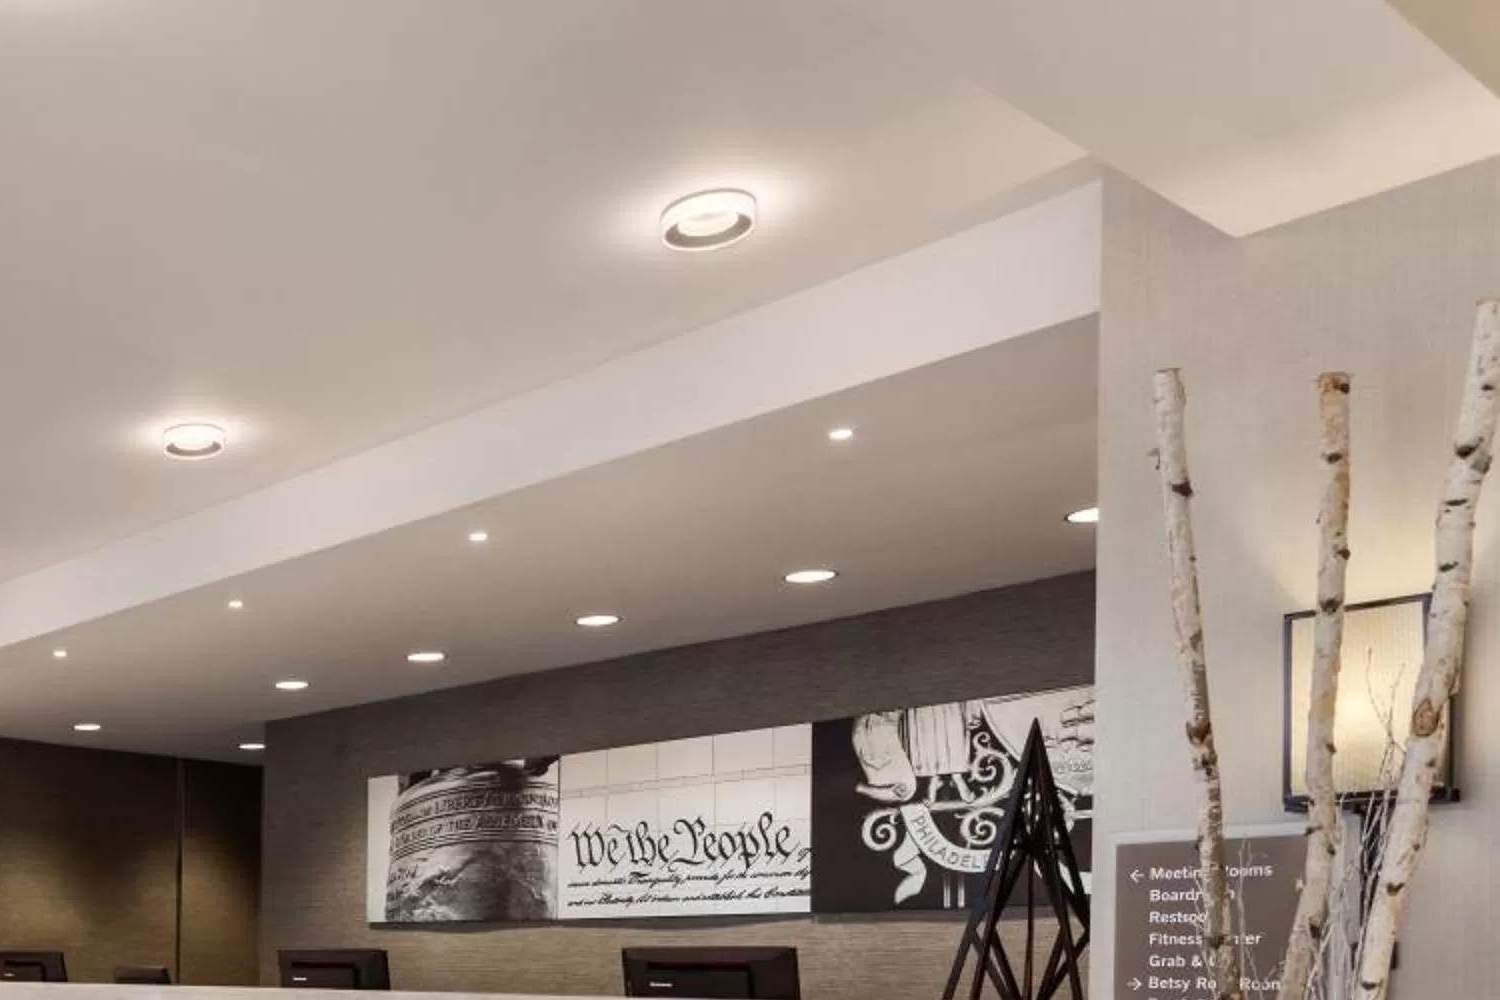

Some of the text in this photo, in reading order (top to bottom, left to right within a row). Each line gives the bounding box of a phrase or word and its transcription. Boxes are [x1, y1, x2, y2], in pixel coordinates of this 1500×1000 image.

[566, 811, 798, 873] We the People
[911, 815, 988, 868] PHILADEL
[1150, 864, 1274, 880] Meetin ooms
[1149, 888, 1236, 902] Boardr
[1149, 911, 1208, 924] Restroo
[1149, 932, 1203, 946] Fitness
[1149, 954, 1187, 968] Grab
[1191, 954, 1203, 968] &
[1148, 975, 1191, 993] Betsy
[1195, 977, 1217, 990] Ro
